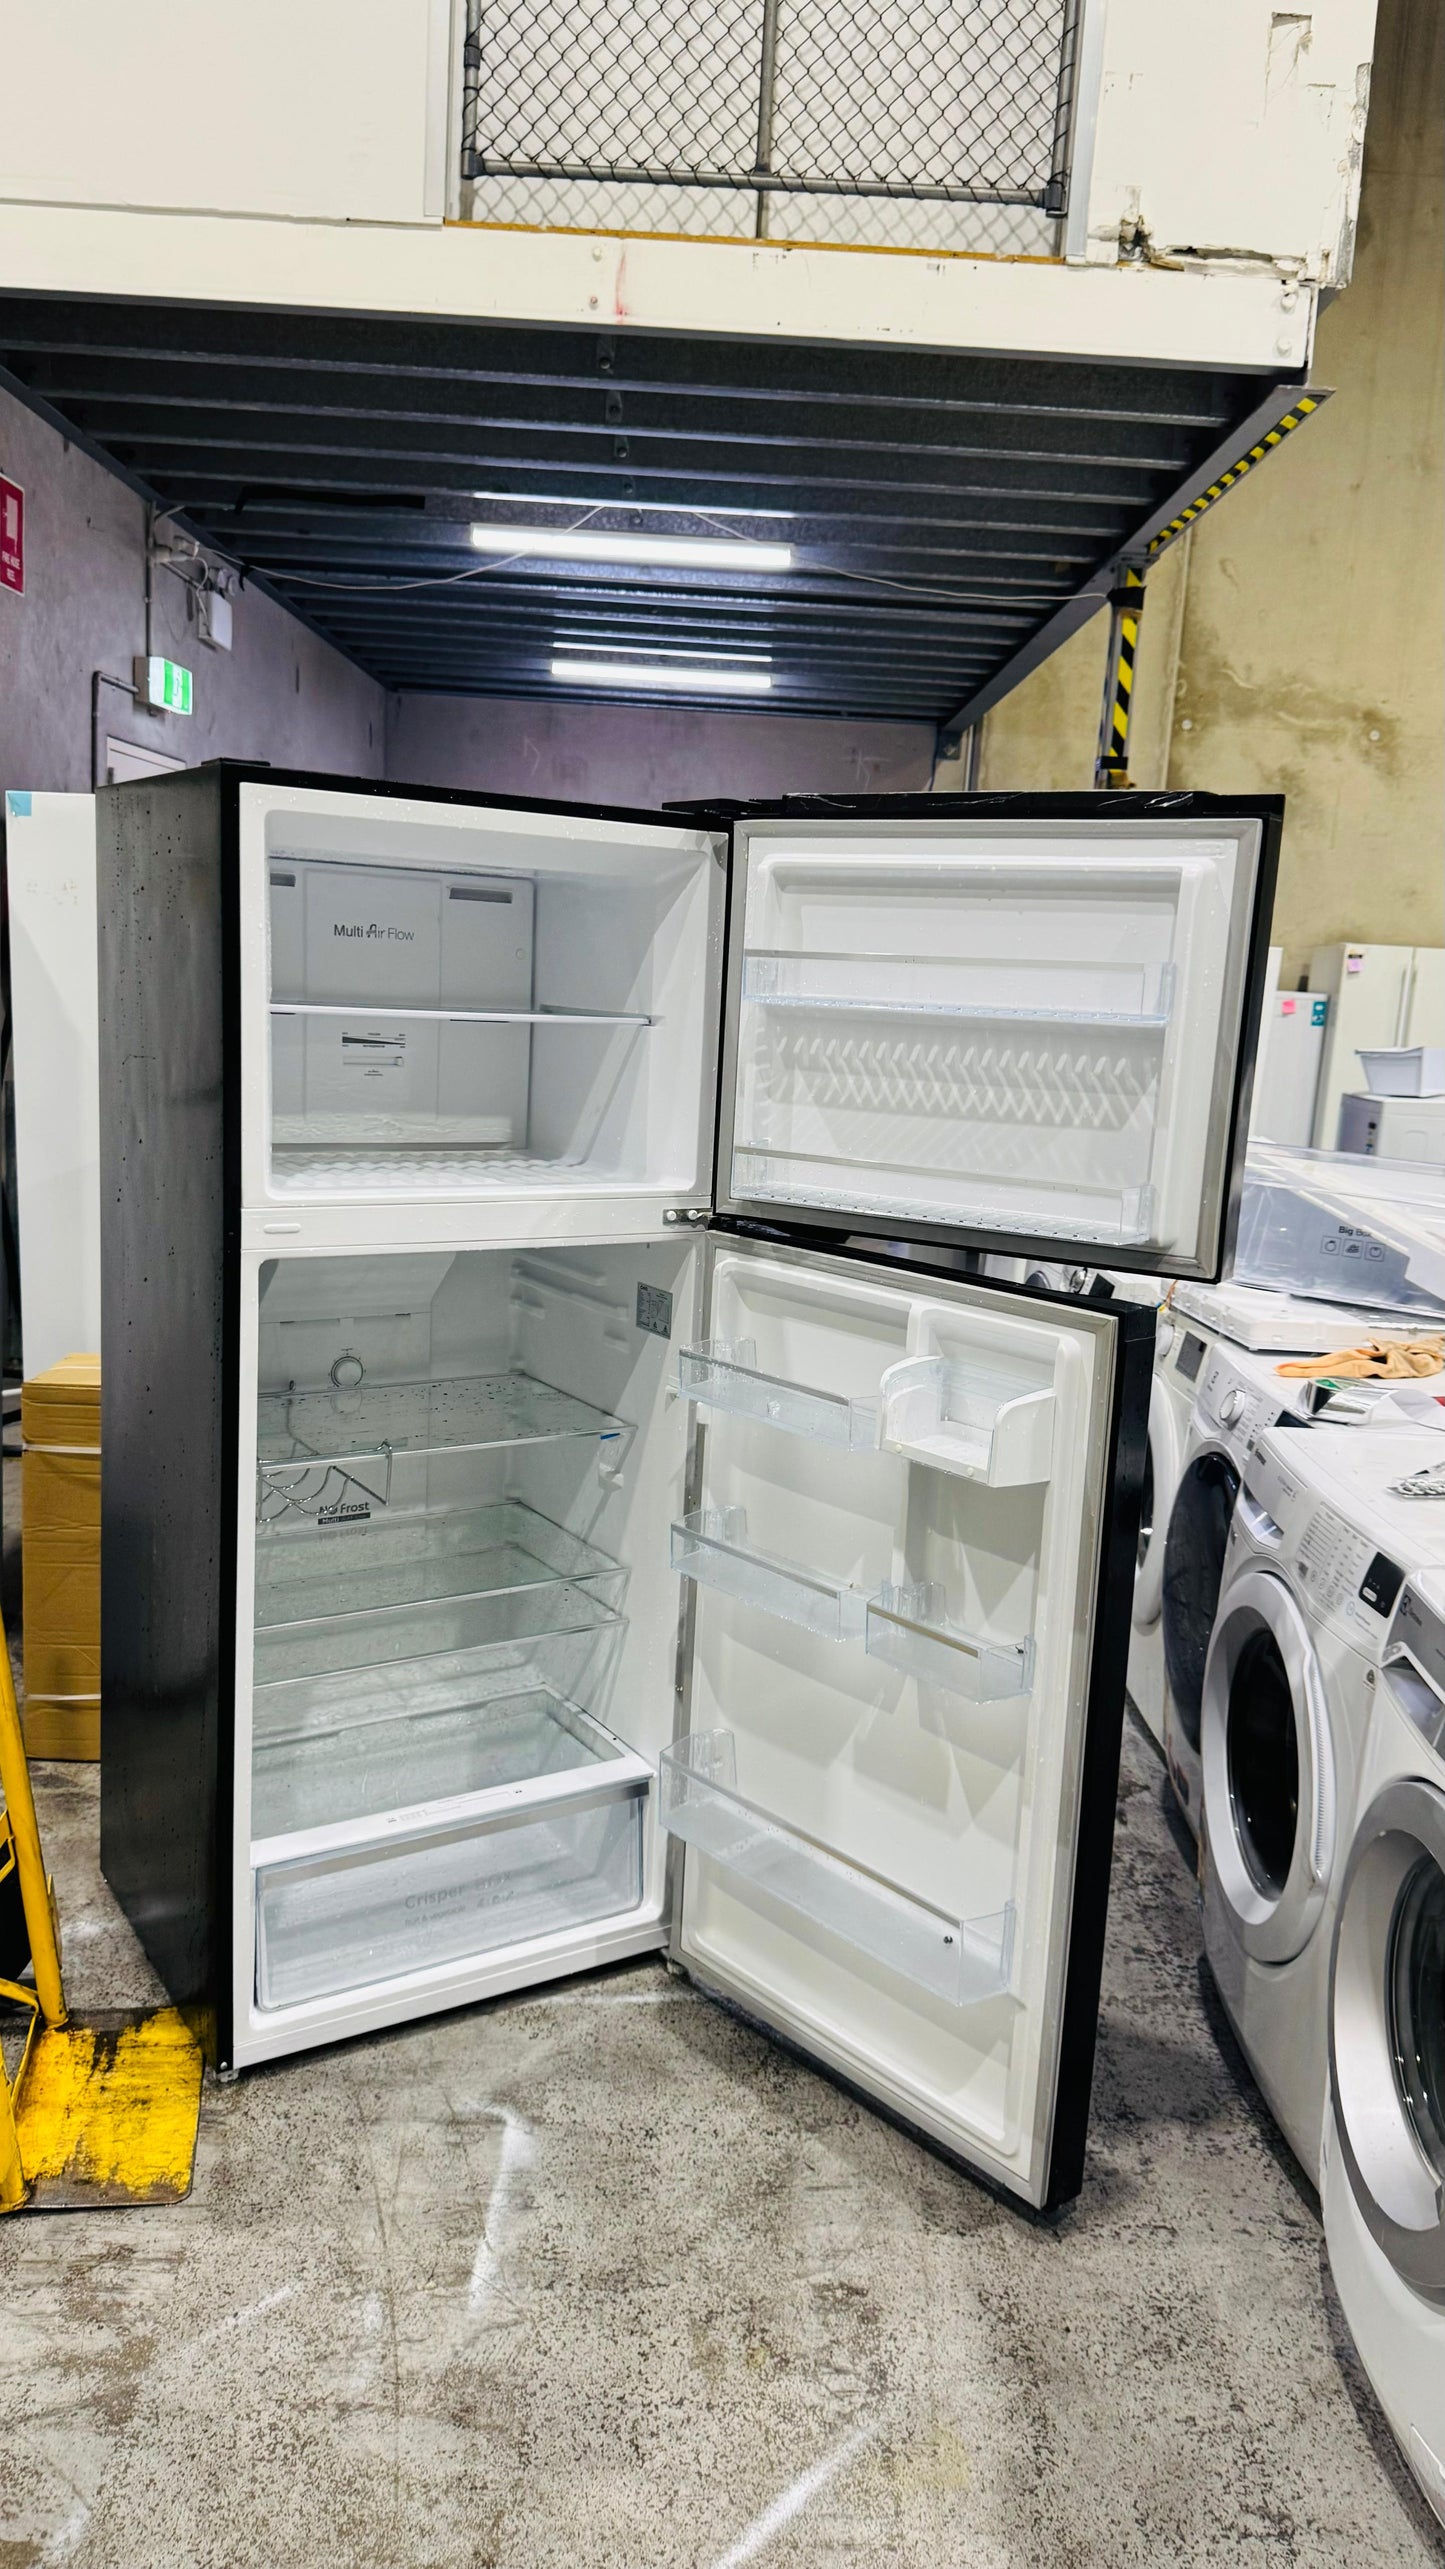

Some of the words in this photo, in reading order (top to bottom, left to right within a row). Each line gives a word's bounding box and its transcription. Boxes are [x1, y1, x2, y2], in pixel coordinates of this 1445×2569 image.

[333, 923, 364, 938] Multi
[387, 927, 415, 941] Flow
[1338, 1225, 1354, 1237] Big
[405, 1884, 464, 1910] Crisper
